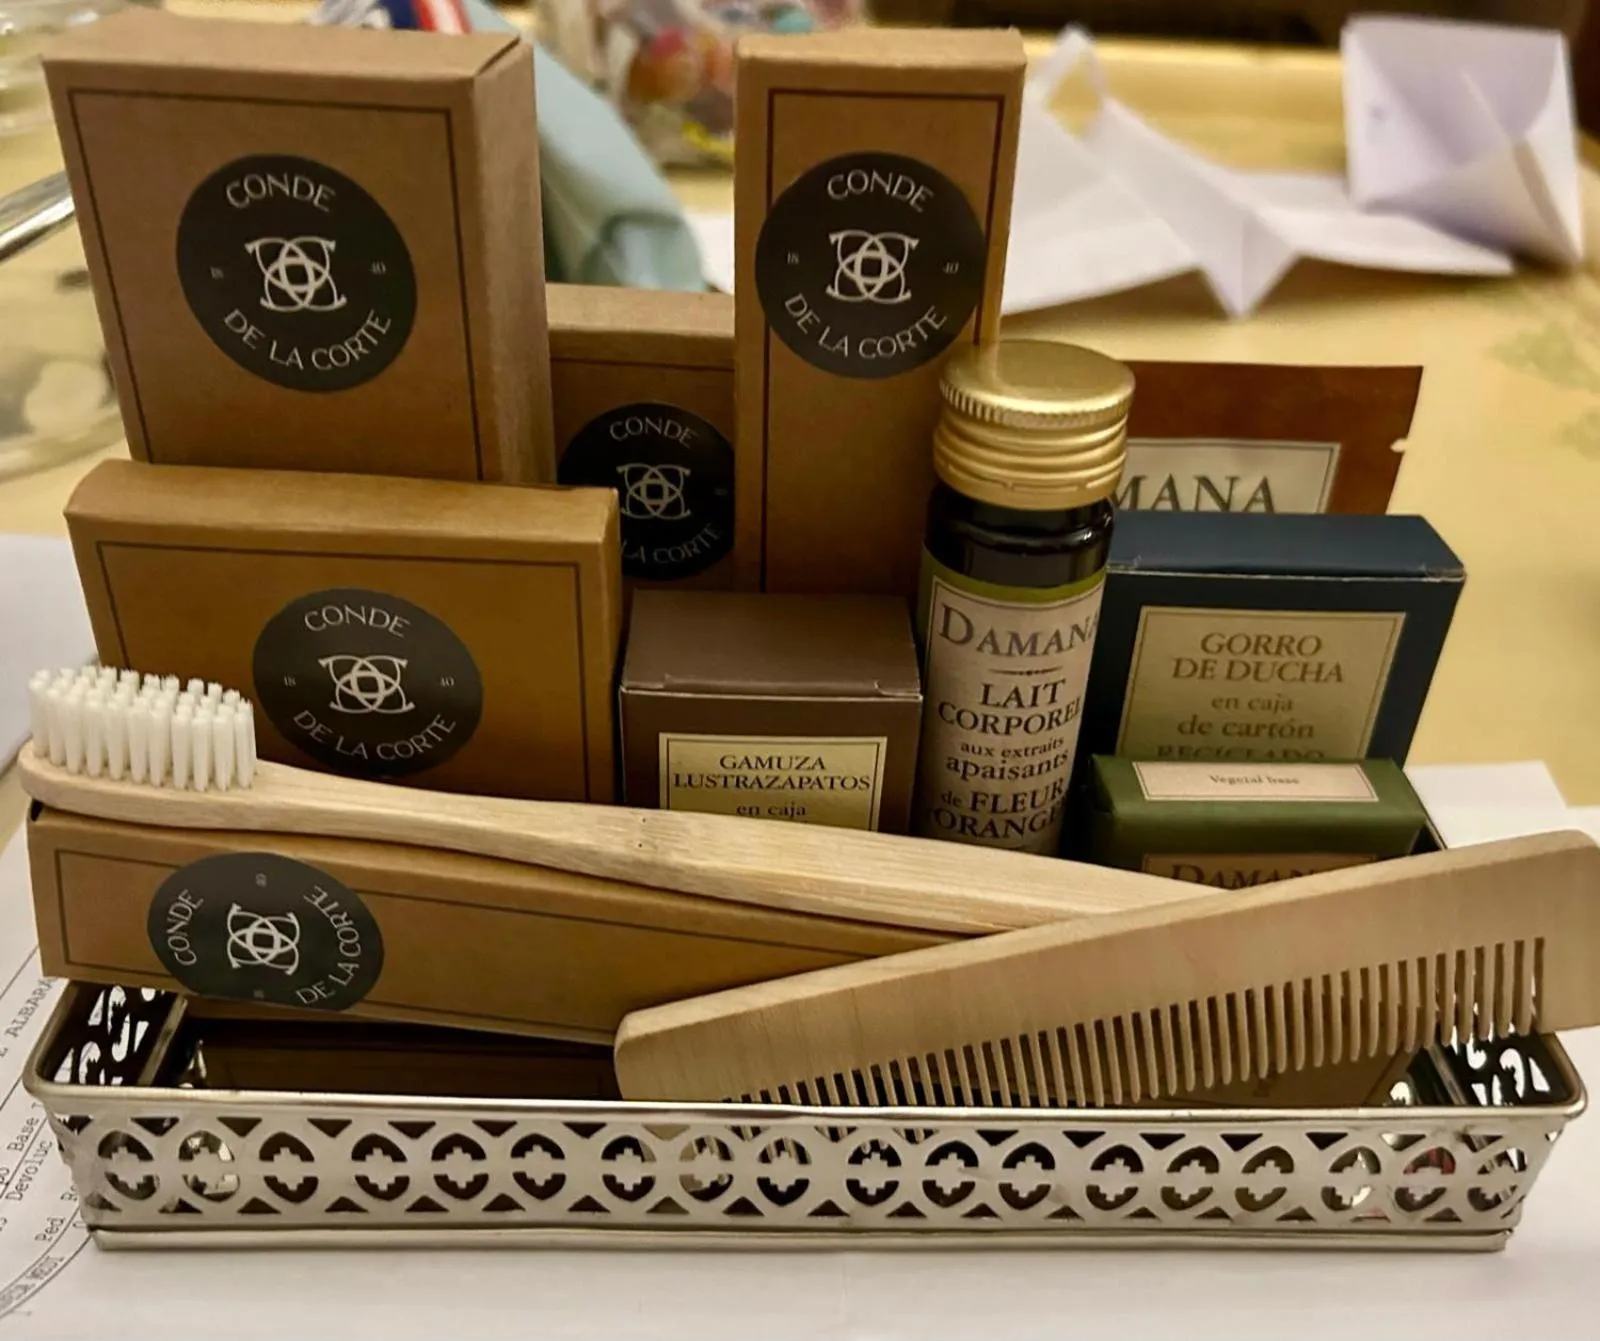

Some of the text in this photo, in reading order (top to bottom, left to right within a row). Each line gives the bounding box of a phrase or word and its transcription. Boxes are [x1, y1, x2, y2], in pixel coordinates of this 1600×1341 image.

[226, 172, 337, 212] CONDE
[827, 168, 935, 213] CONDE
[224, 307, 392, 371] DE LA CORTE
[784, 292, 948, 359] DE LA CORTE
[610, 416, 699, 450] CONDE
[304, 604, 411, 638] CONDE
[1200, 632, 1323, 657] GORRO
[1171, 657, 1343, 684] DE DUCHA
[979, 677, 1066, 709] LAIT
[1211, 692, 1293, 716] en caja
[293, 709, 457, 761] DE LA CORTE
[1177, 713, 1316, 740] de cartón
[719, 754, 827, 771] GAMUZA
[946, 748, 1069, 782] apaisants
[960, 736, 1065, 760] aux extraits
[673, 772, 871, 791] LUSTRAZAPATOS
[941, 778, 1065, 815] de FLEUR
[736, 800, 807, 818] en caja
[166, 888, 204, 967] CONDE
[296, 885, 362, 1005] DE LA CORTE
[6, 1117, 40, 1152] Base
